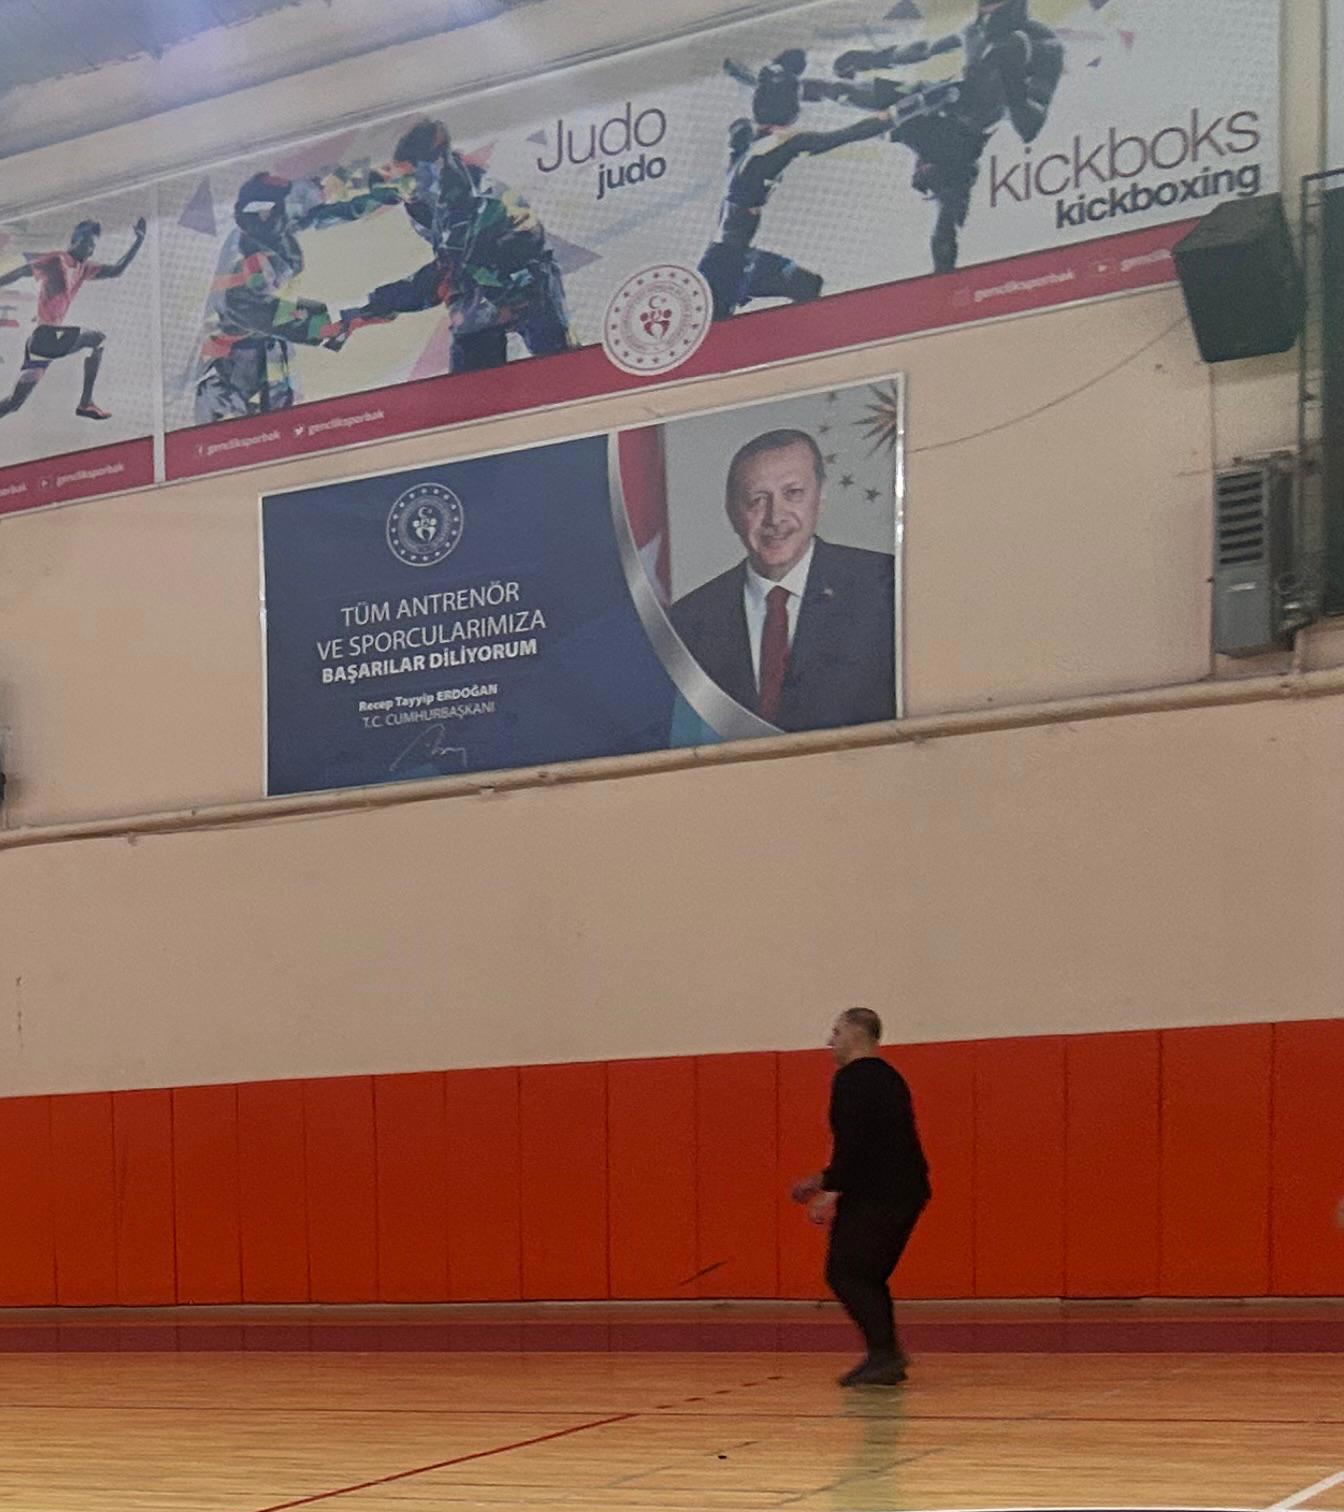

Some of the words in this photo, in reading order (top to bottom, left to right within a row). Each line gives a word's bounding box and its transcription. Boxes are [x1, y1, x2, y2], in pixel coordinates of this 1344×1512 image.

[535, 102, 667, 173] Judo
[989, 107, 1261, 207] kickboks
[596, 153, 667, 199] judo
[1055, 163, 1261, 229] kickboxing
[341, 601, 390, 627] TÜM
[396, 581, 520, 620] ANTRENÖR
[317, 638, 343, 661] VE
[350, 609, 547, 656] SPORCULARIMIZA
[322, 653, 426, 684] BAŞARILAR
[429, 638, 538, 670] DİLİYORUM
[359, 700, 393, 712] Recep
[395, 693, 434, 708] Tayyip
[436, 684, 498, 701] ERDOĞAN
[385, 701, 496, 727] CUMHURBAŞKANI
